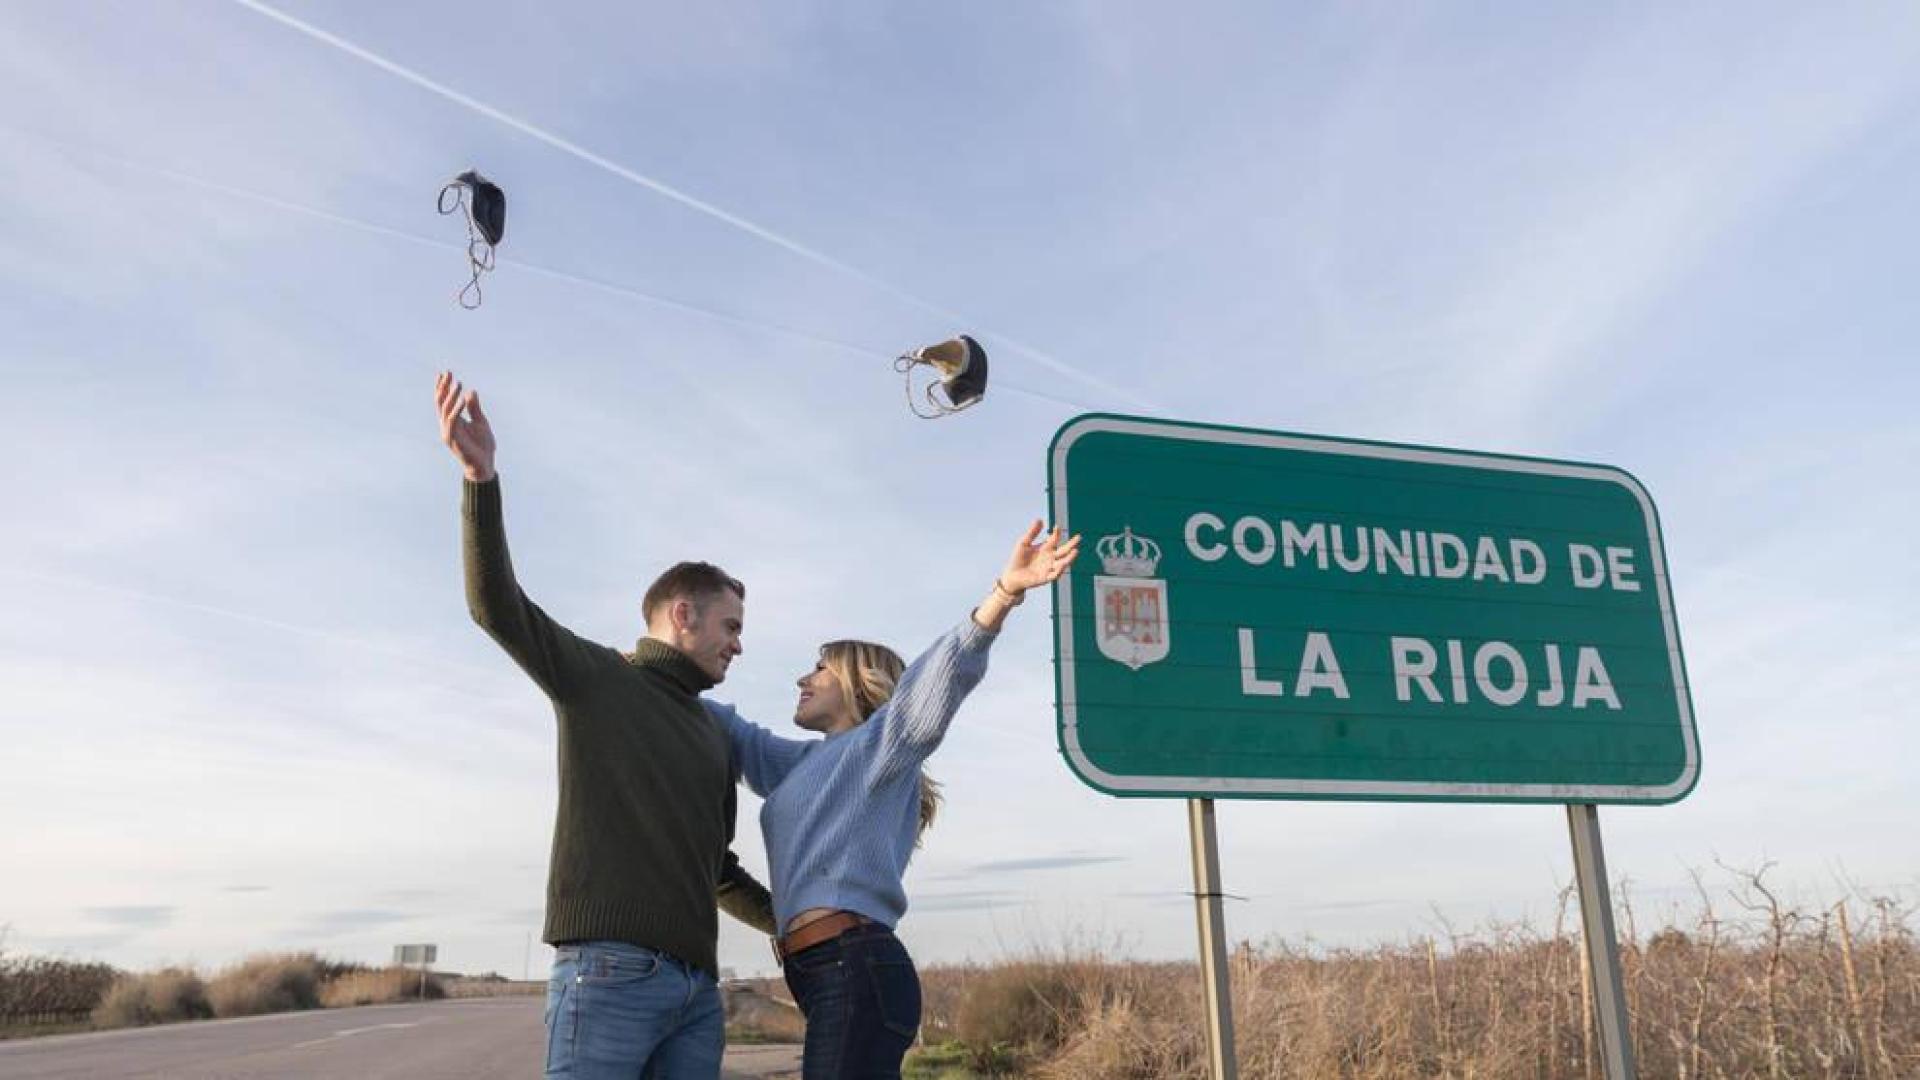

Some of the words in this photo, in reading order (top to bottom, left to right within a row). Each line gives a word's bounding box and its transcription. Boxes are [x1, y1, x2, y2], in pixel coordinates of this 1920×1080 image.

[1184, 512, 1546, 585] COMUNIDAD
[1570, 543, 1641, 592] DE
[1238, 628, 1350, 699] LA
[1391, 636, 1622, 709] RIOJA
